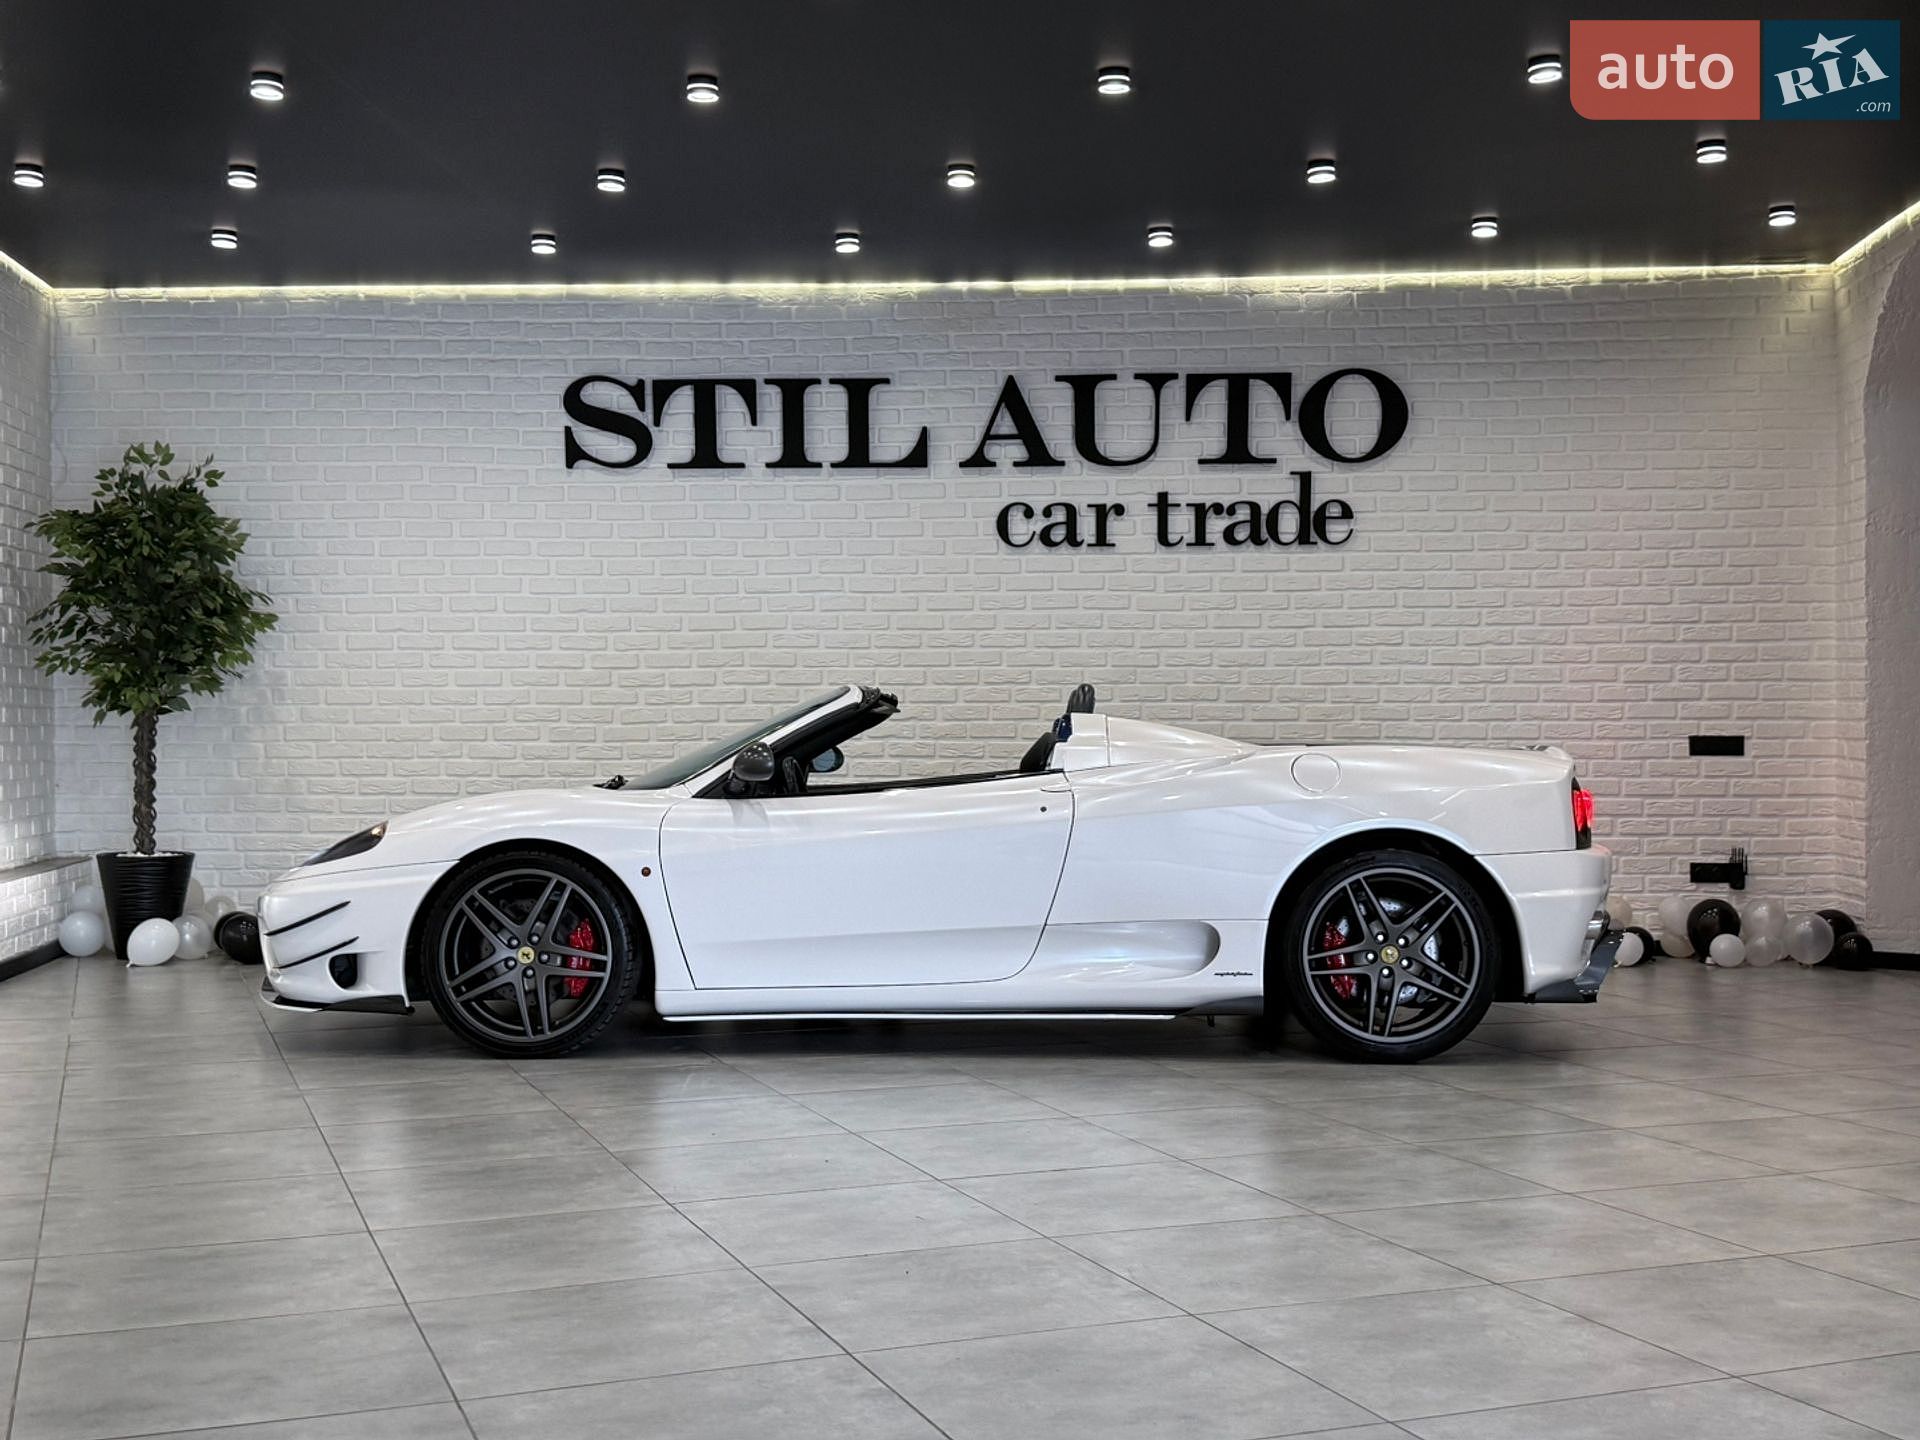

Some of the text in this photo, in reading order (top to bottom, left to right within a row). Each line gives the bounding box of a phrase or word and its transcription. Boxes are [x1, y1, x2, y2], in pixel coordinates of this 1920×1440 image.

[562, 367, 1409, 470] STIL AUTO
[995, 470, 1354, 548] car trade
